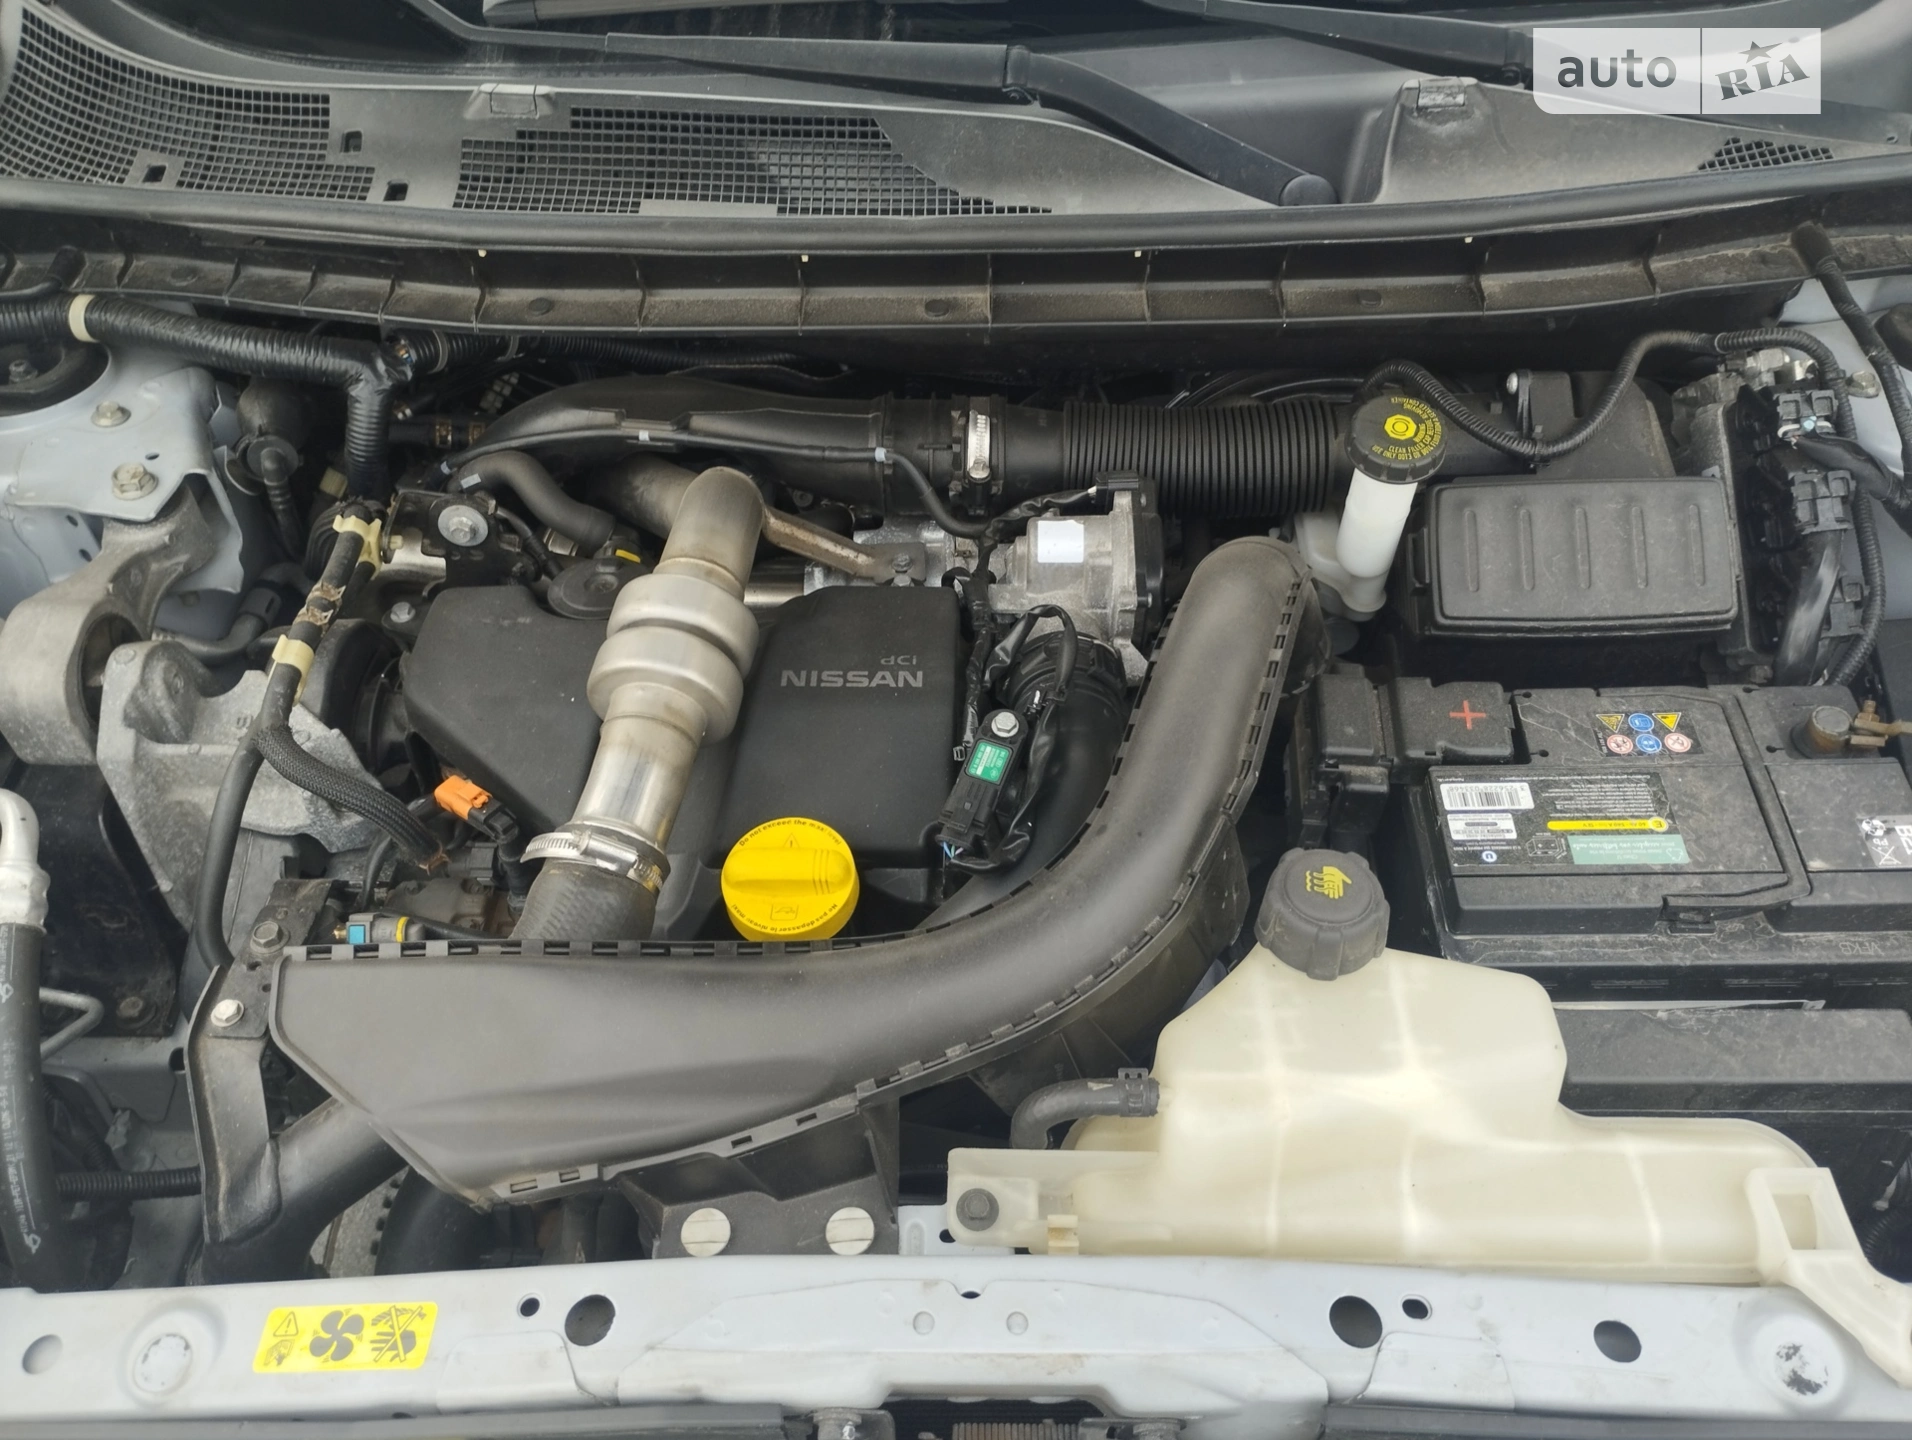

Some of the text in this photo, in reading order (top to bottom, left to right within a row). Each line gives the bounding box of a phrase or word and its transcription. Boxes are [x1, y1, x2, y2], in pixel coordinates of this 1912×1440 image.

[1371, 444, 1384, 455] USE
[1382, 449, 1397, 459] ONLY
[1397, 453, 1413, 461] DOT3
[1412, 449, 1423, 459] OR
[1420, 443, 1434, 456] DOT4
[1388, 445, 1407, 454] CLEAN
[1408, 442, 1427, 453] FILLER
[880, 655, 917, 665] dCi
[780, 670, 924, 688] NISSAN
[739, 837, 750, 847] Do
[749, 828, 762, 839] not
[763, 820, 793, 831] exceed
[1872, 837, 1889, 847] Pb
[829, 903, 839, 913] Ne
[815, 911, 828, 922] pas
